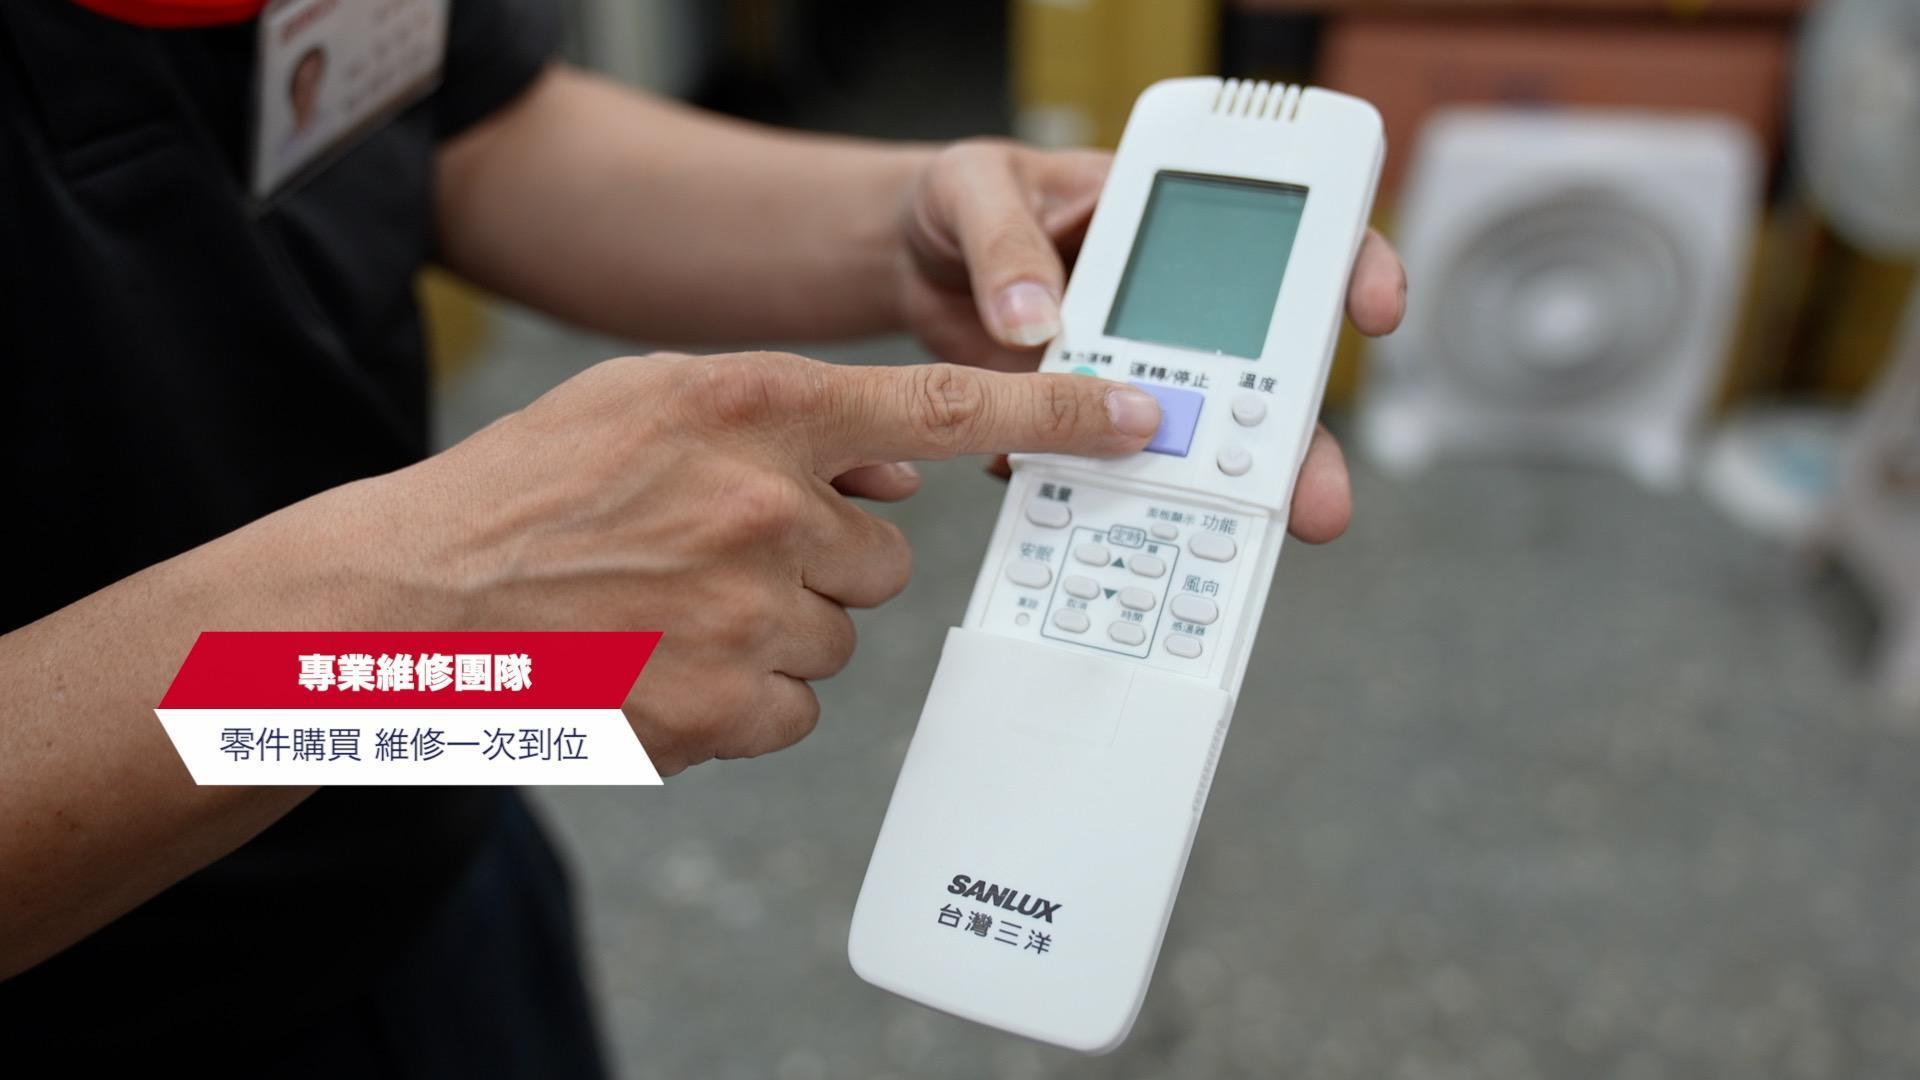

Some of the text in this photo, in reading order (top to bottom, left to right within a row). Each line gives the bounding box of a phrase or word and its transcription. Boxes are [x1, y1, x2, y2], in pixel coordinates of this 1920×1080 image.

[1200, 514, 1239, 535] 功能
[1182, 574, 1219, 597] 風向
[947, 874, 1063, 923] SANLUX
[937, 903, 1052, 955] 台灣三洋
